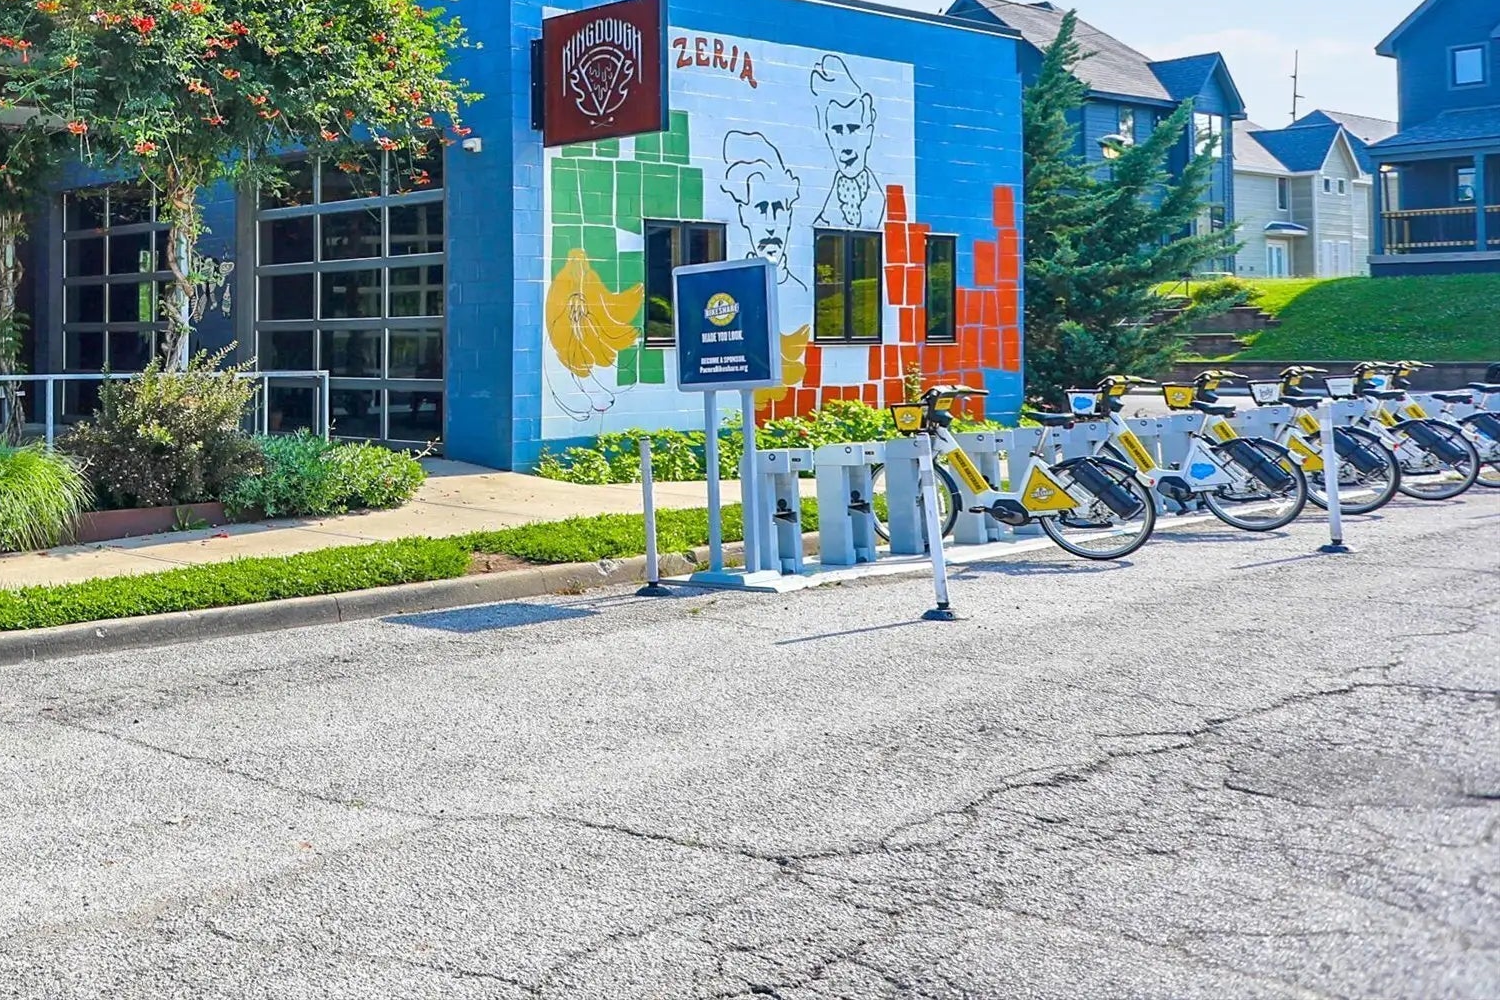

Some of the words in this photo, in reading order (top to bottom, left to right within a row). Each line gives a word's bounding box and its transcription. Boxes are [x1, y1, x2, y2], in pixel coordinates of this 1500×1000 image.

[673, 37, 758, 89] ZERIA
[702, 332, 717, 343] MADE
[717, 331, 728, 342] YOU
